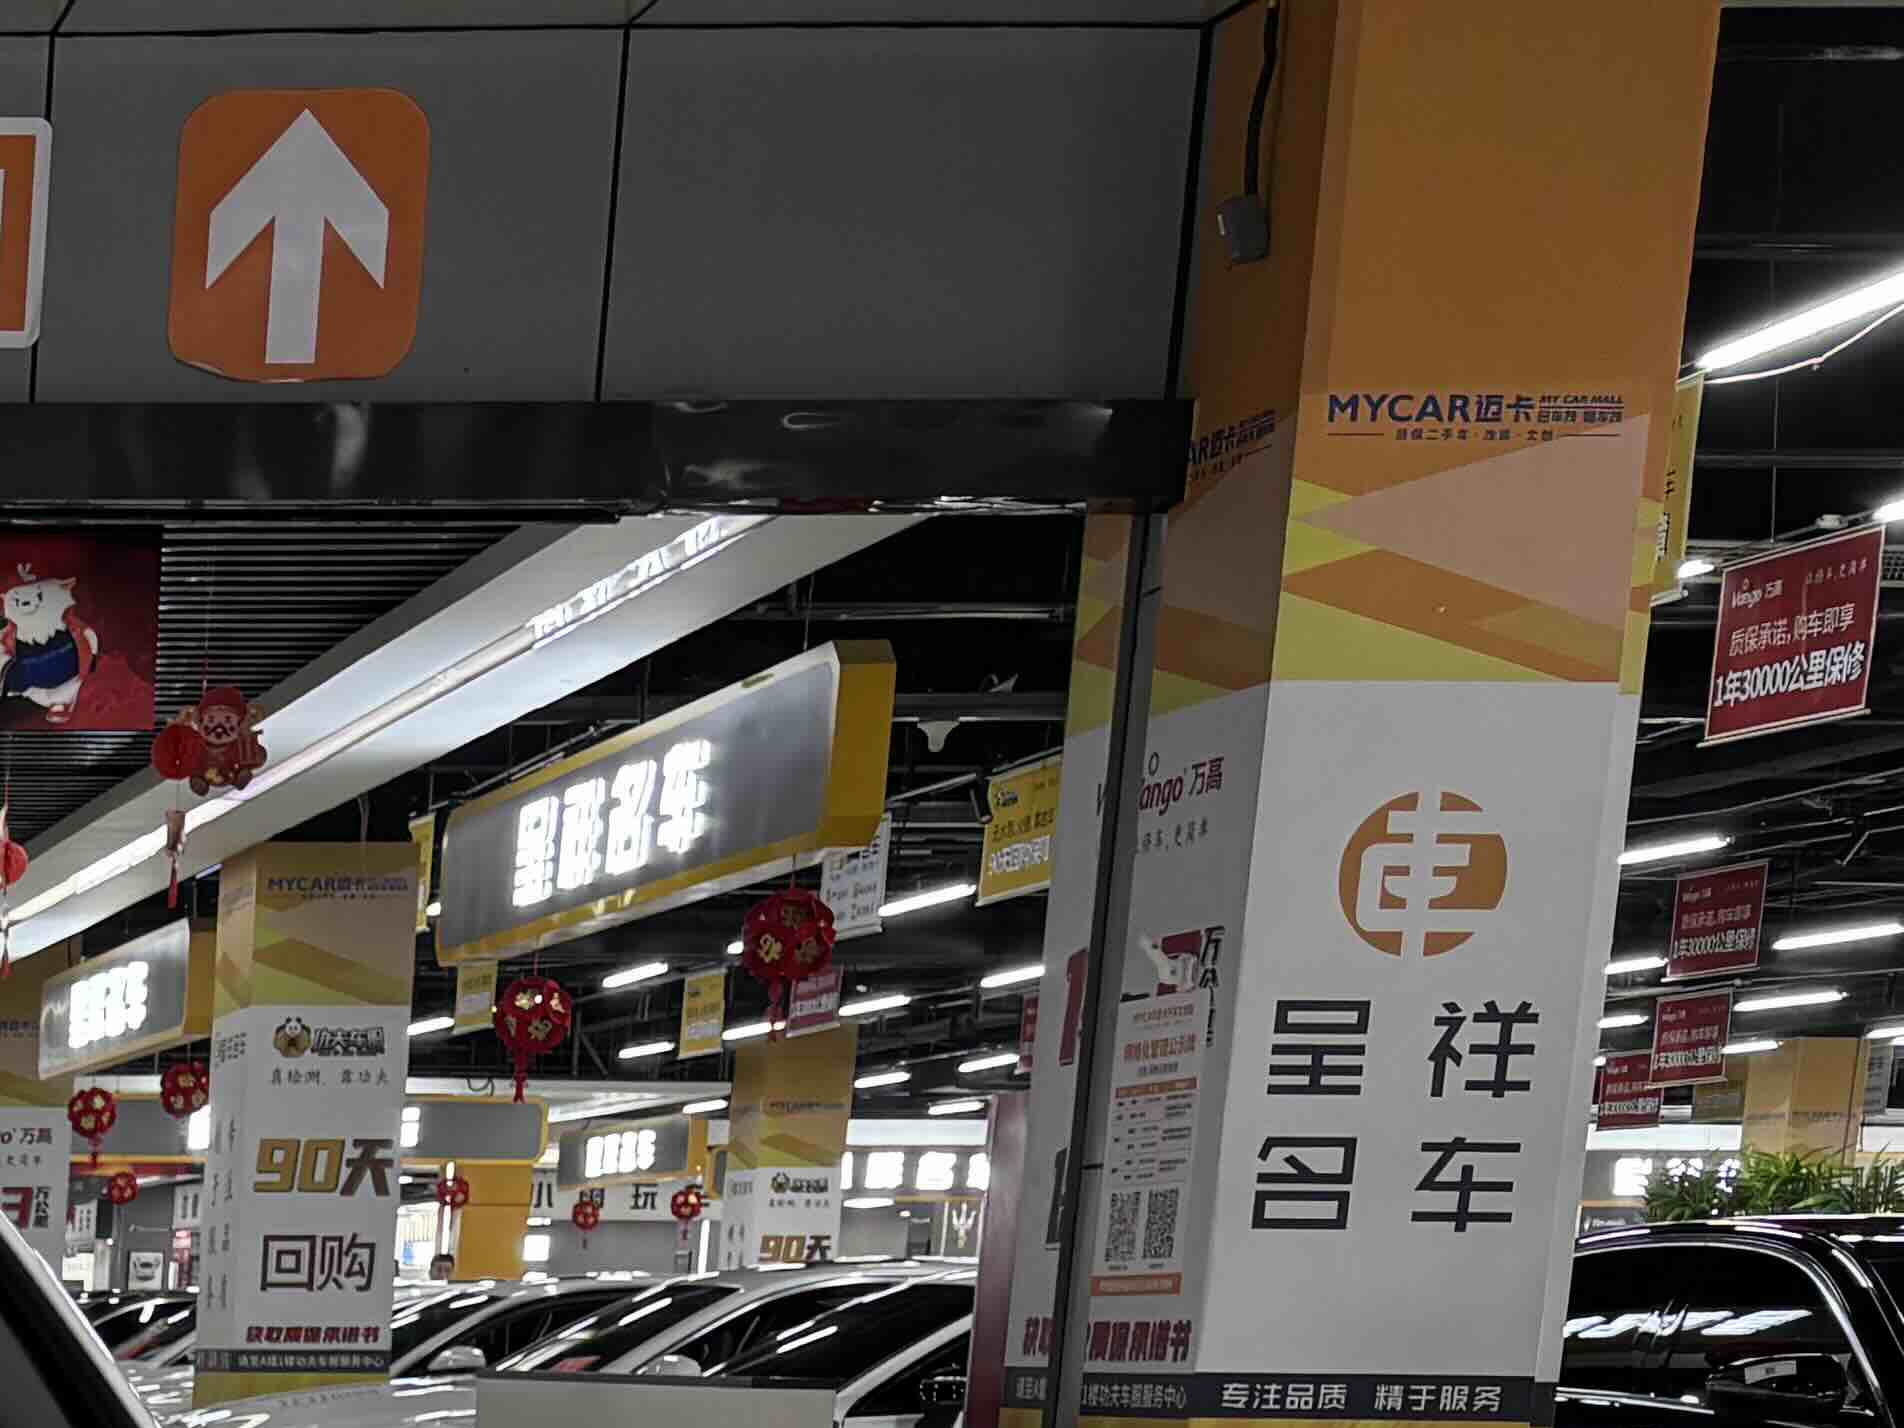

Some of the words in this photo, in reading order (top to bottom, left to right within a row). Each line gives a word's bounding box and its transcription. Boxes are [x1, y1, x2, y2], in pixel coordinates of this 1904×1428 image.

[1713, 640, 1866, 708] 1年30000公里保修
[1188, 756, 1225, 796] 万高
[1266, 998, 1541, 1100] 呈祥
[253, 1138, 395, 1197] 90天
[1250, 1135, 1524, 1235] 名车
[259, 1233, 377, 1293] 回购
[758, 1234, 832, 1264] 90天
[1221, 1383, 1348, 1410] 专注品质
[1373, 1384, 1503, 1412] 精于服务
